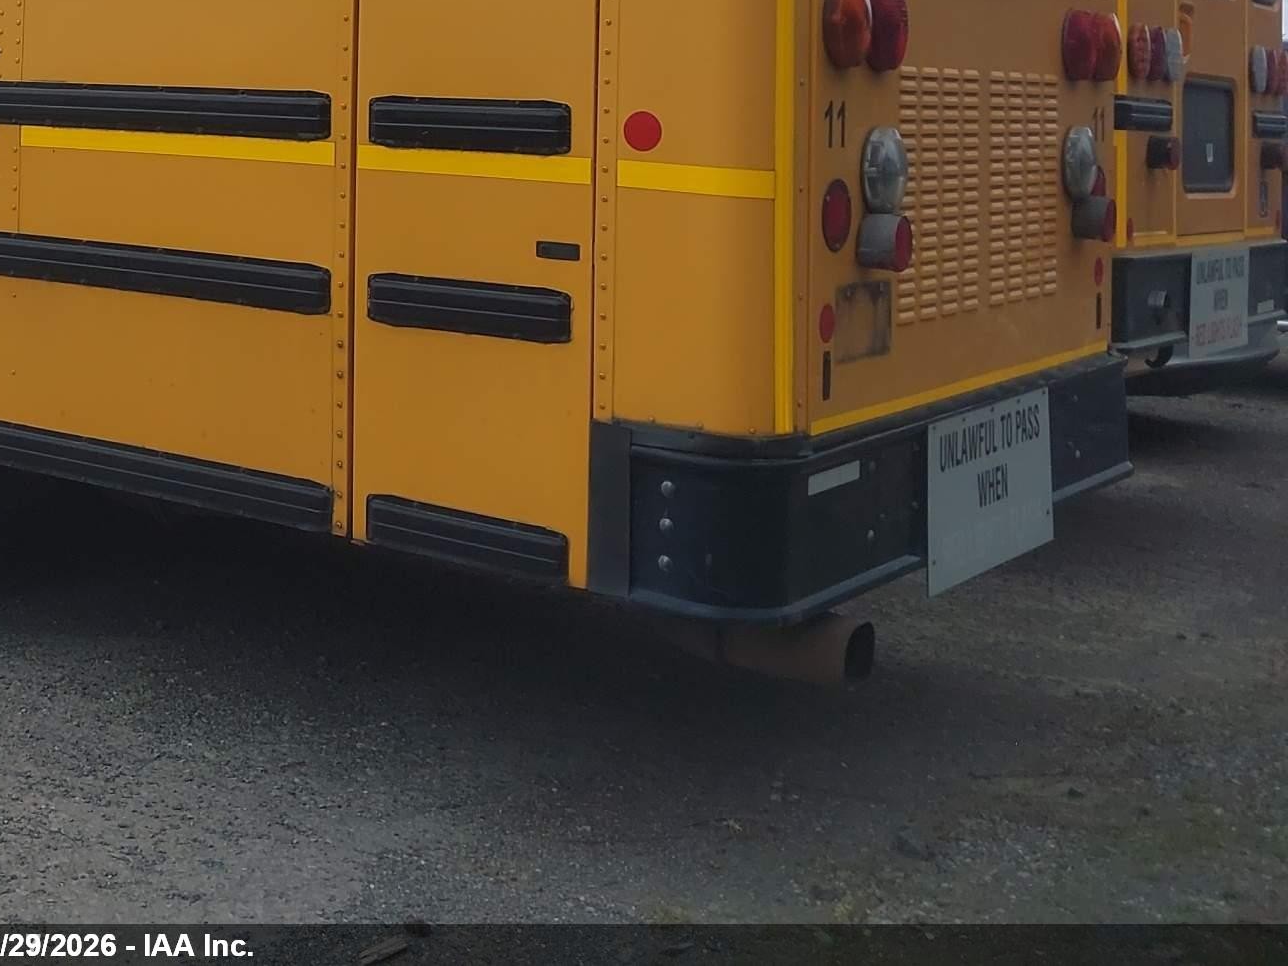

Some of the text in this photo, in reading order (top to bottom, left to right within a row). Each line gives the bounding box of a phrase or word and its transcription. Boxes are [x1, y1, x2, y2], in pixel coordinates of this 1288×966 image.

[824, 100, 845, 148] 11
[1093, 106, 1104, 143] 11
[940, 403, 1040, 472] UNLAWFUL TO PASS
[977, 463, 1009, 508] WHEN
